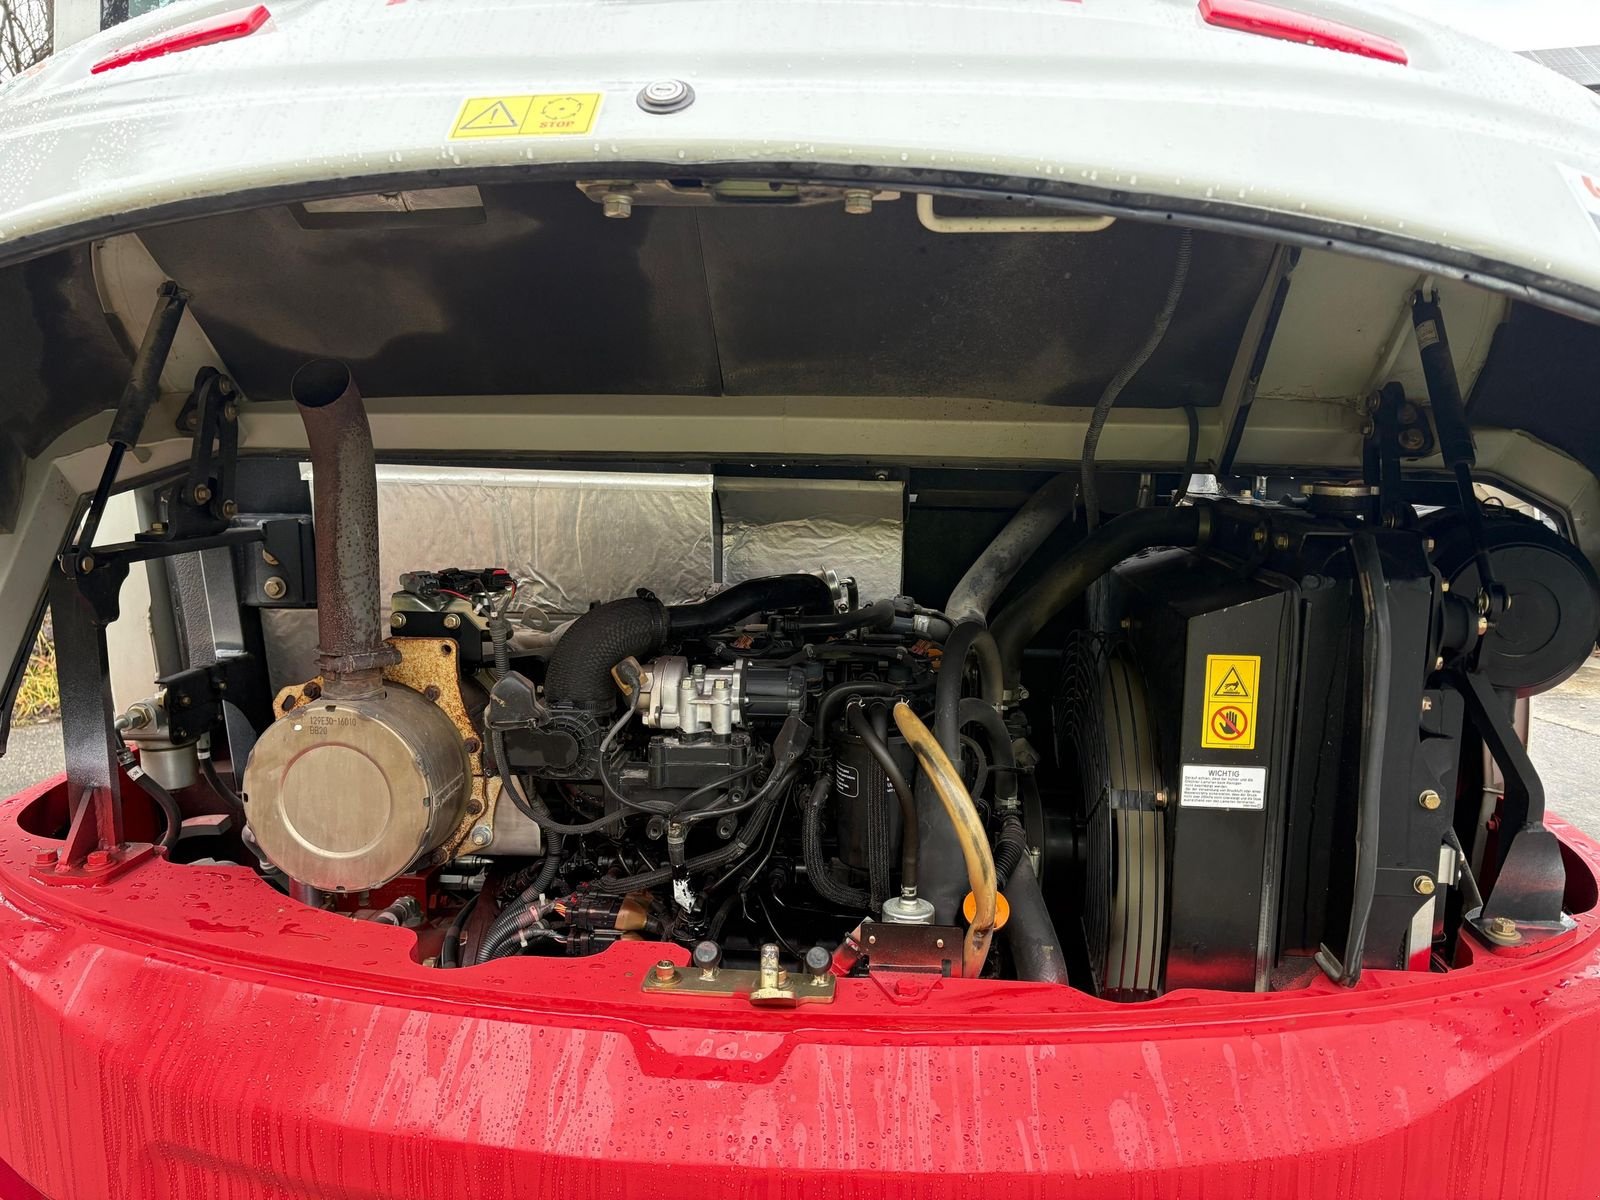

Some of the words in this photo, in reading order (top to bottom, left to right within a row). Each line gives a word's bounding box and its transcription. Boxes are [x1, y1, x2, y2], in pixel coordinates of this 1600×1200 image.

[539, 121, 575, 129] STOP
[310, 716, 357, 726] 129E30-16010
[1208, 769, 1240, 777] WICHTIG
